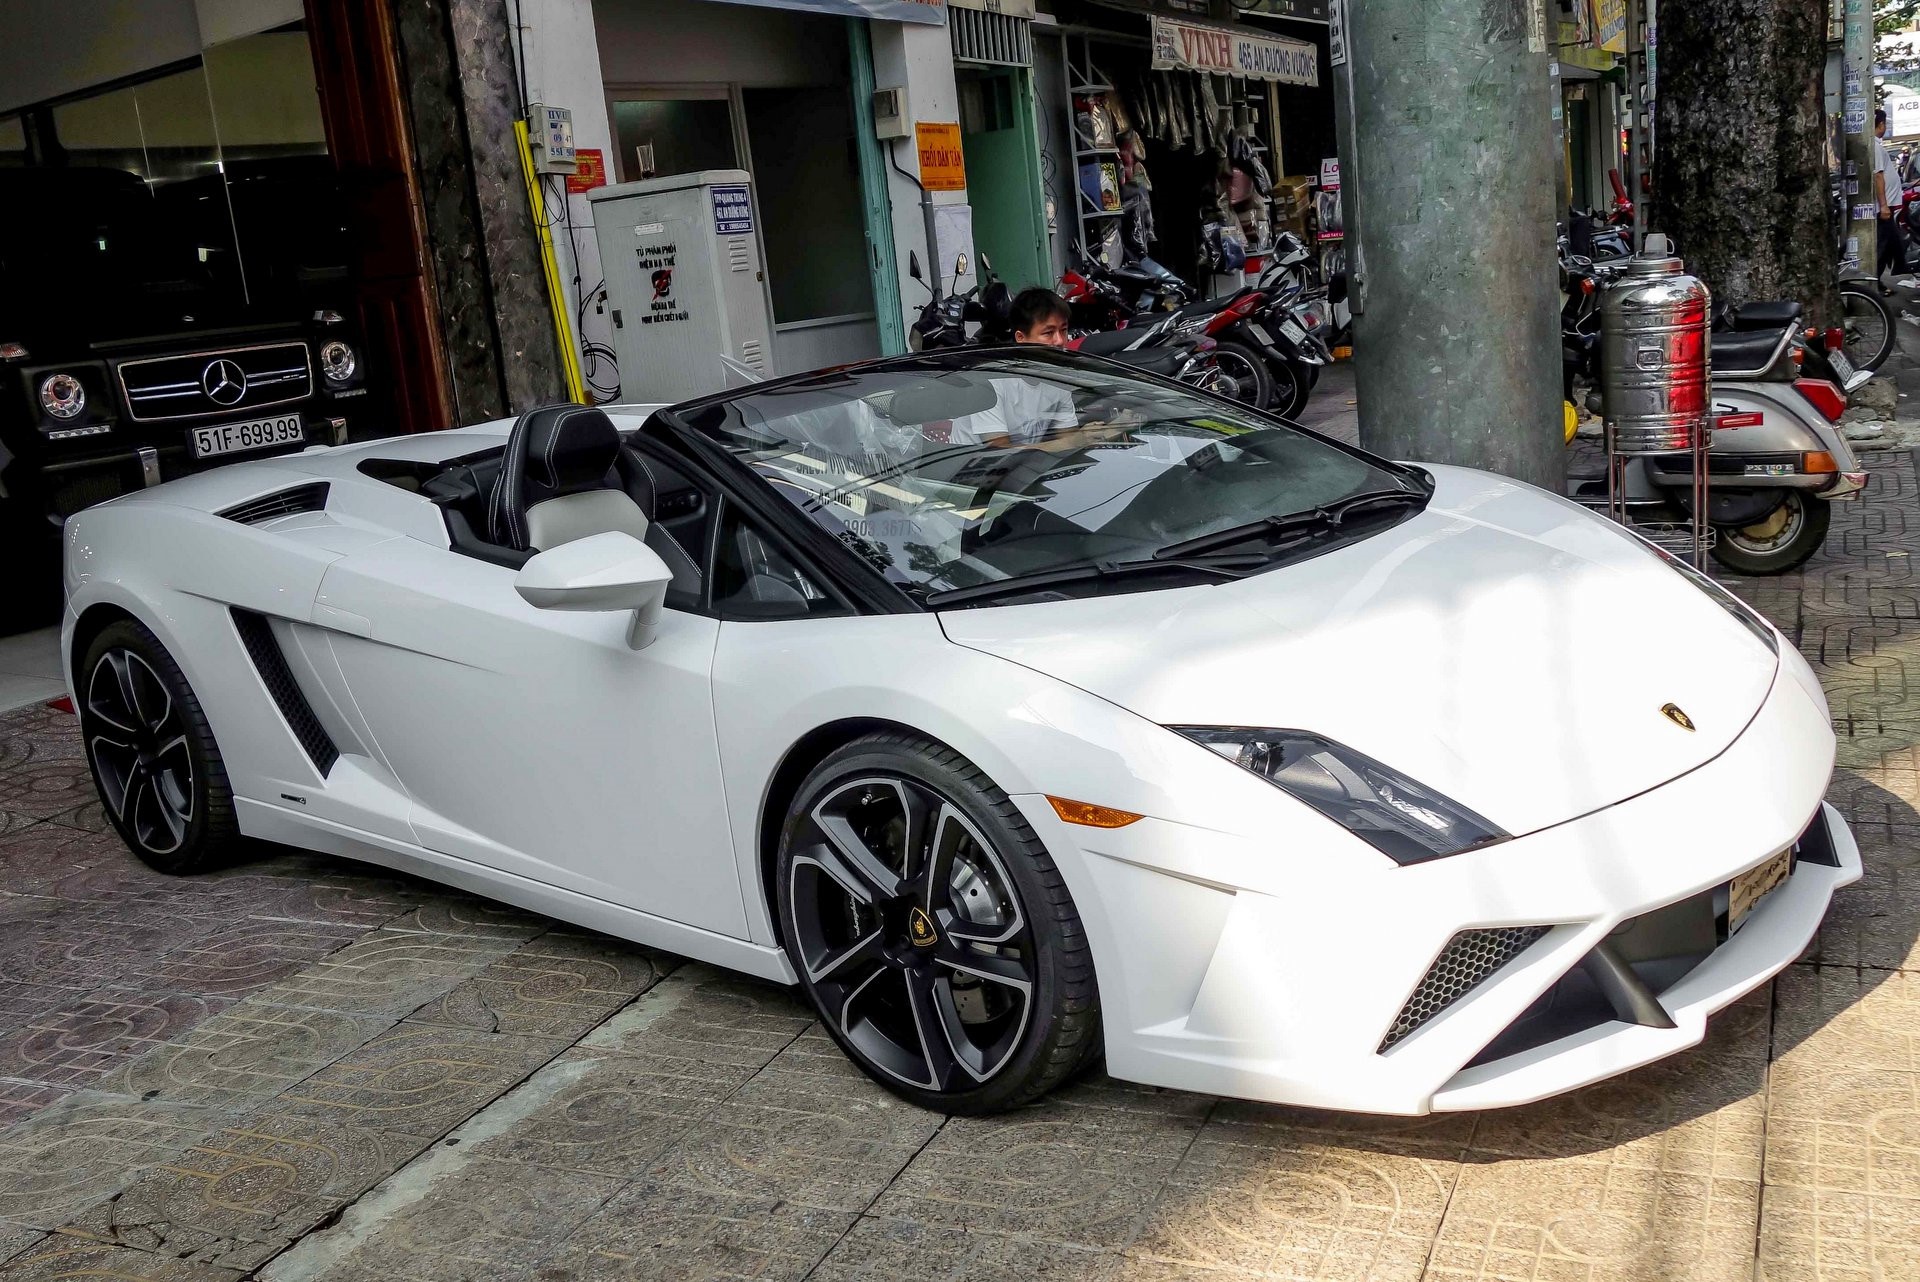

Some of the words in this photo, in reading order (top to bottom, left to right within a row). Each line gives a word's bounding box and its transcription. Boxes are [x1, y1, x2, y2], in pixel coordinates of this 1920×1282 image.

[1178, 28, 1233, 68] VINH
[1239, 42, 1253, 70] 465
[1254, 45, 1265, 71] AN
[1265, 44, 1291, 75] DƯƠNG
[1898, 102, 1919, 111] ACB
[198, 418, 300, 453] 51F-699.99
